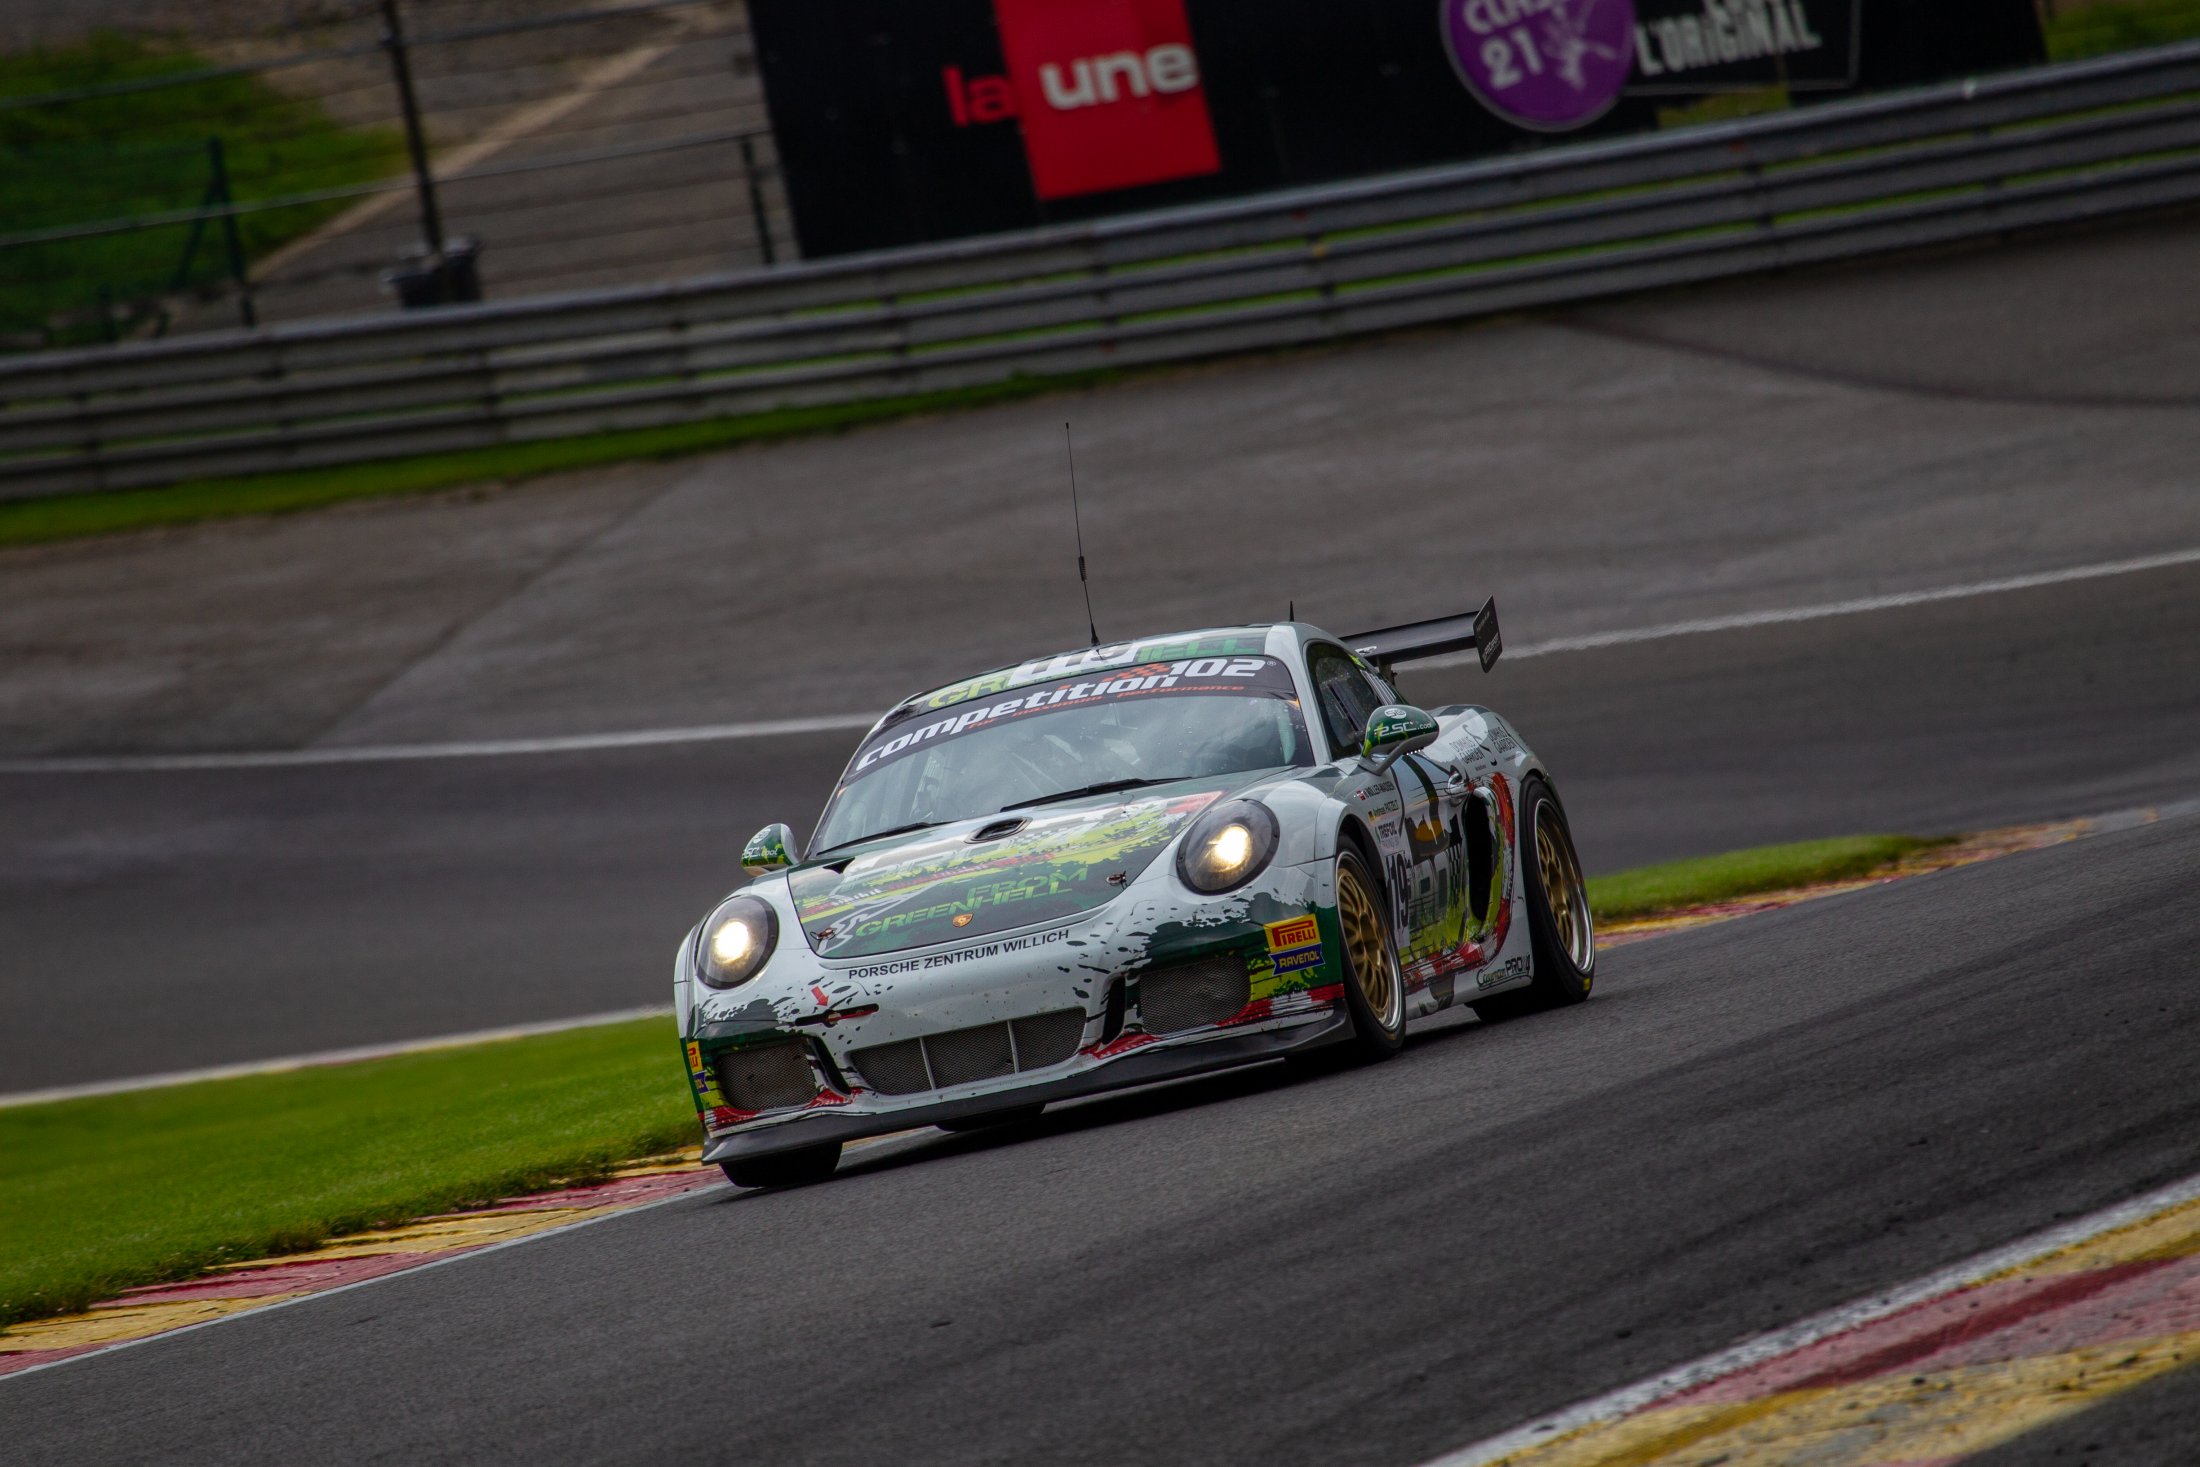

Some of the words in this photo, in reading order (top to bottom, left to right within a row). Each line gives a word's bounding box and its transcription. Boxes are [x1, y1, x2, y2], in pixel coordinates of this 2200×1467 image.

[1480, 26, 1544, 90] 21
[942, 65, 1016, 127] la
[1038, 43, 1198, 109] une
[1117, 685, 1246, 698] performance
[1272, 920, 1316, 947] PIRELLI
[849, 958, 921, 979] PORSCHE
[924, 946, 999, 969] ZENTRUM
[1003, 929, 1070, 953] WILLICH
[1279, 951, 1320, 968] RAVENOL
